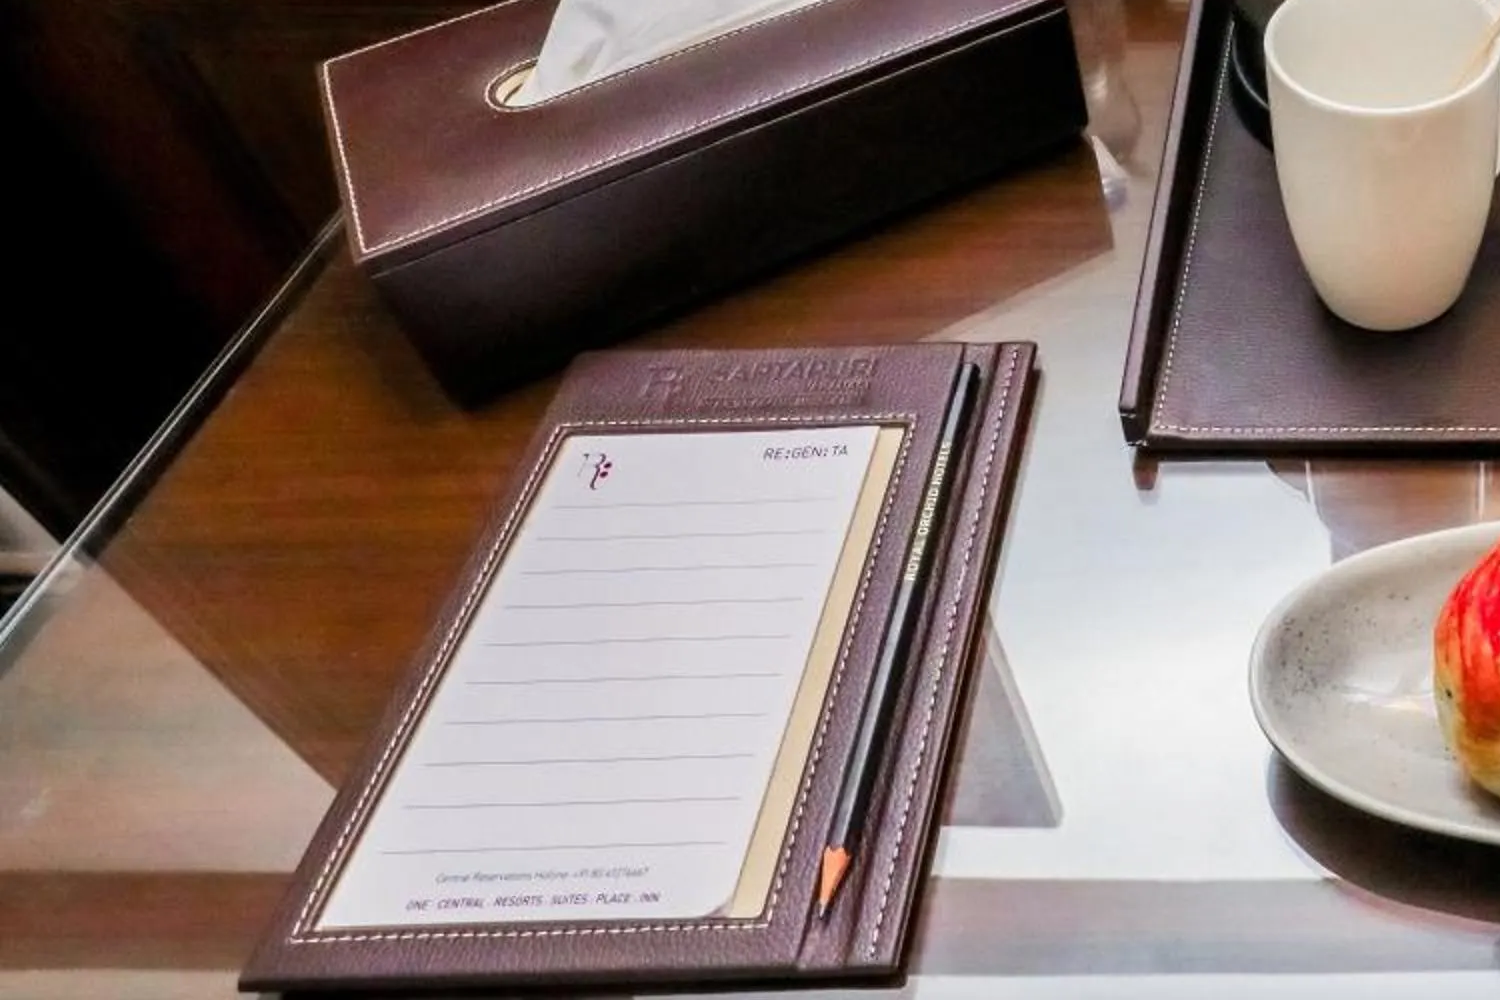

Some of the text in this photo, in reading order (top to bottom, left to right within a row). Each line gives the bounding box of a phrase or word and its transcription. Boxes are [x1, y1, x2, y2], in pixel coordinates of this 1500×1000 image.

[917, 486, 939, 536] ORCHID
[473, 869, 532, 881] Reservations
[406, 899, 428, 911] ONE
[437, 897, 485, 909] CENTRAL
[493, 895, 543, 907] RESORTS
[552, 893, 588, 905] SUITES
[639, 892, 660, 903] INN
